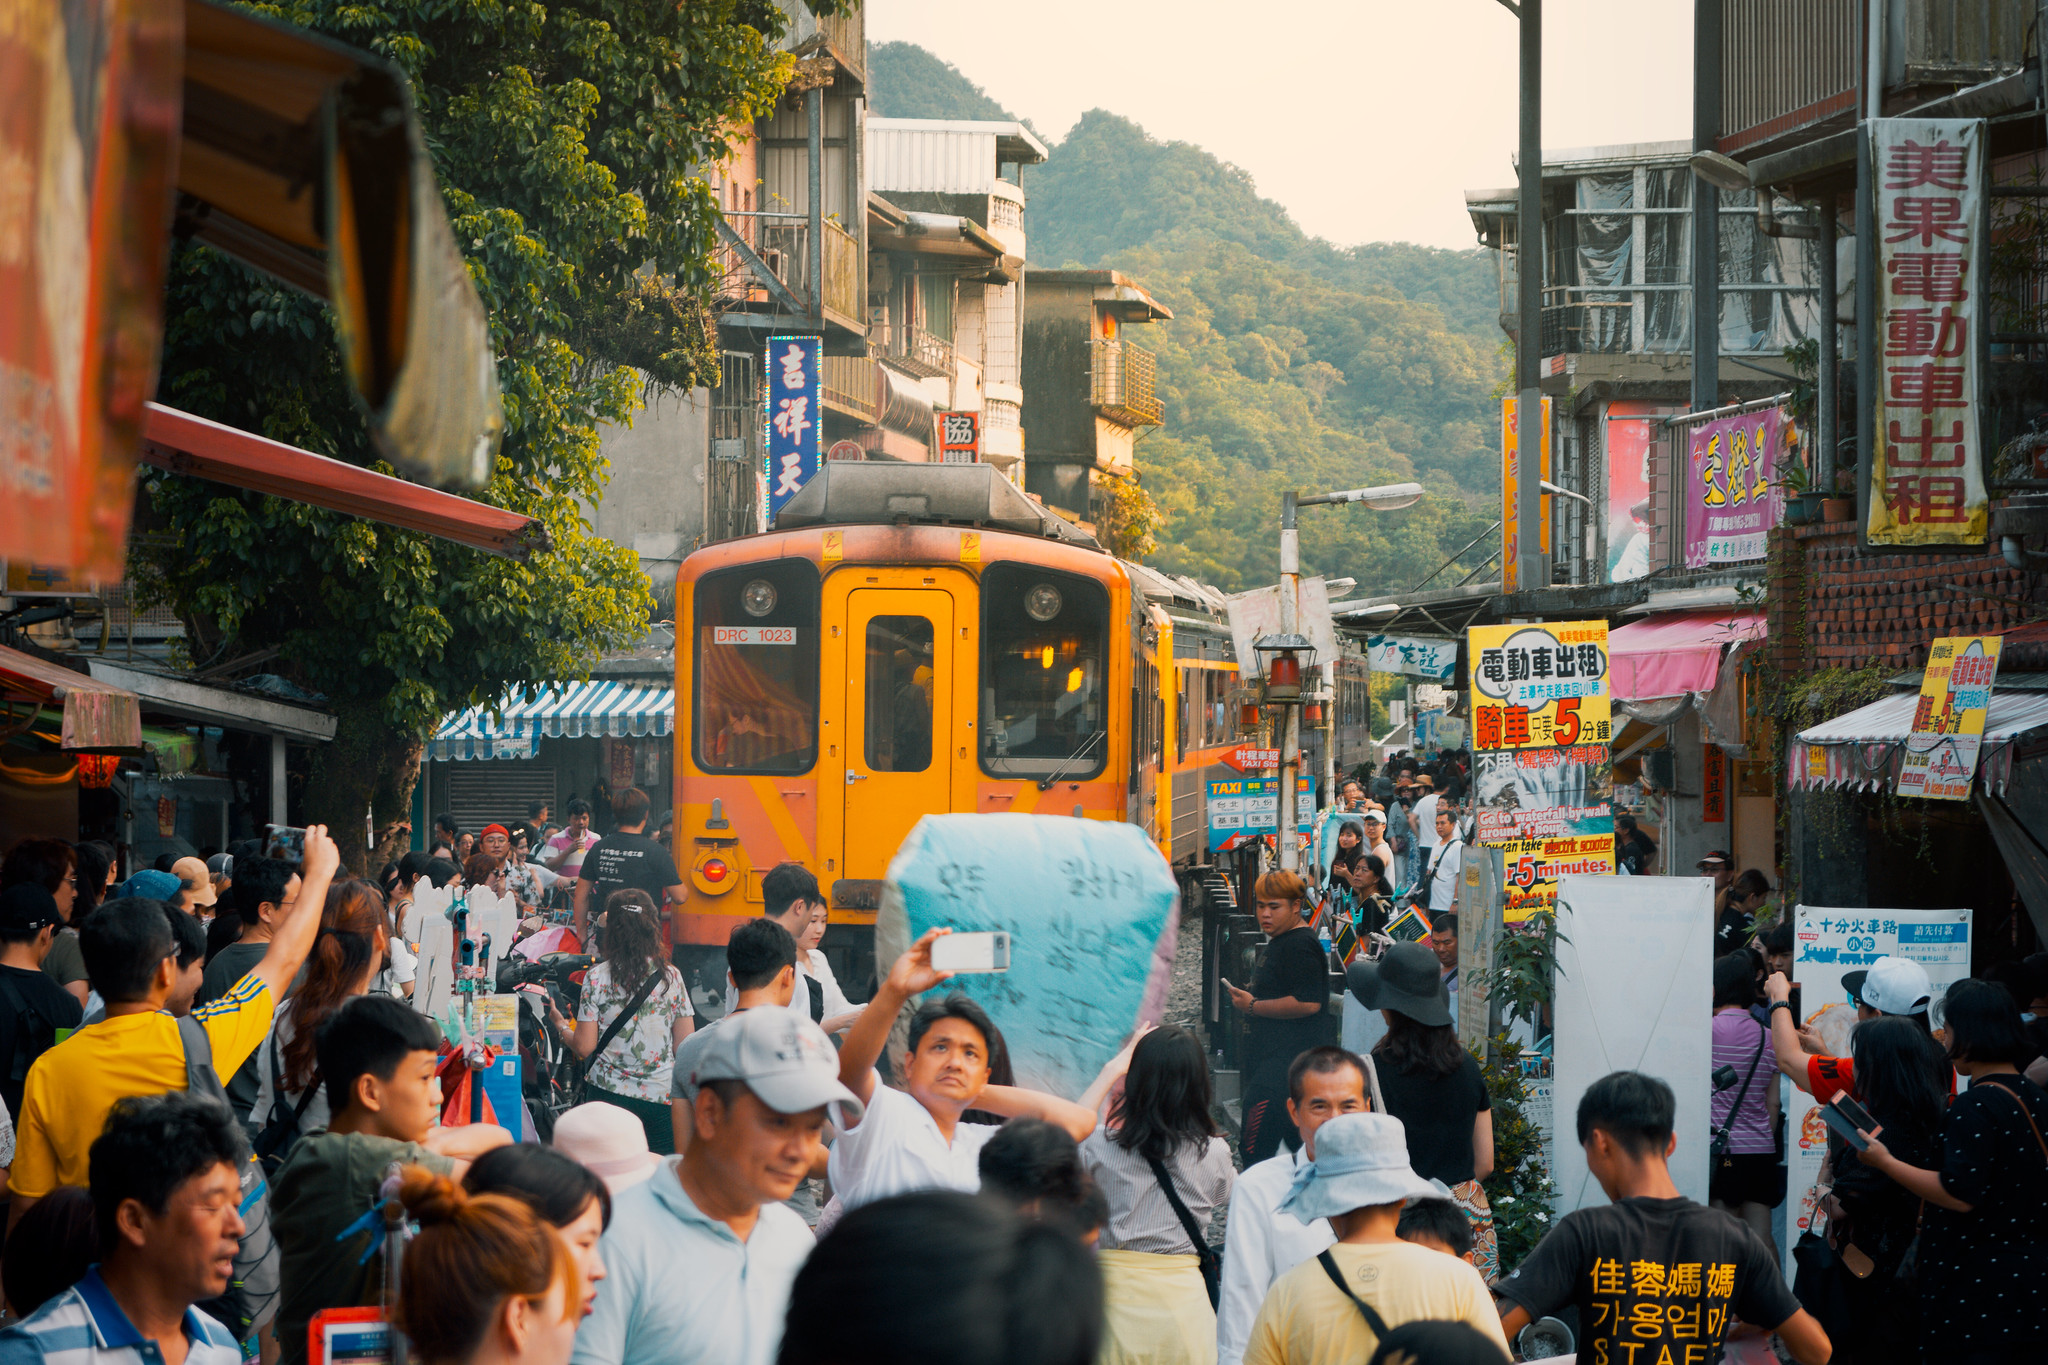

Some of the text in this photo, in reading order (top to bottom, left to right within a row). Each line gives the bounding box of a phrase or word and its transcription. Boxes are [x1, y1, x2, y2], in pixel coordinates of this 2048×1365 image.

[1884, 139, 1971, 526] 美果電動車出租
[773, 344, 812, 497] 吉祥天
[717, 629, 792, 642] DRC 1023
[1558, 629, 1607, 643] 美果電動車出租
[1482, 644, 1600, 683] 電動車出租
[1951, 655, 1996, 686] 電動車出租
[1519, 681, 1600, 700] 去瀑布走路來回1小時
[1211, 782, 1242, 795] TAXI
[1478, 802, 1611, 826] Go to waterfall by walk
[1479, 825, 1521, 839] around
[1521, 839, 1542, 852] take
[1544, 838, 1577, 855] electric
[1580, 836, 1613, 852] scooter
[1516, 854, 1536, 887] 5
[1538, 859, 1612, 877] minutes.
[1819, 917, 1899, 935] 十分火車路
[1914, 926, 1954, 936] 請先付款
[1848, 937, 1875, 950] 小吃
[1590, 1257, 1737, 1299] 佳蓉媽媽
[1592, 1300, 1728, 1339] 가용엄마
